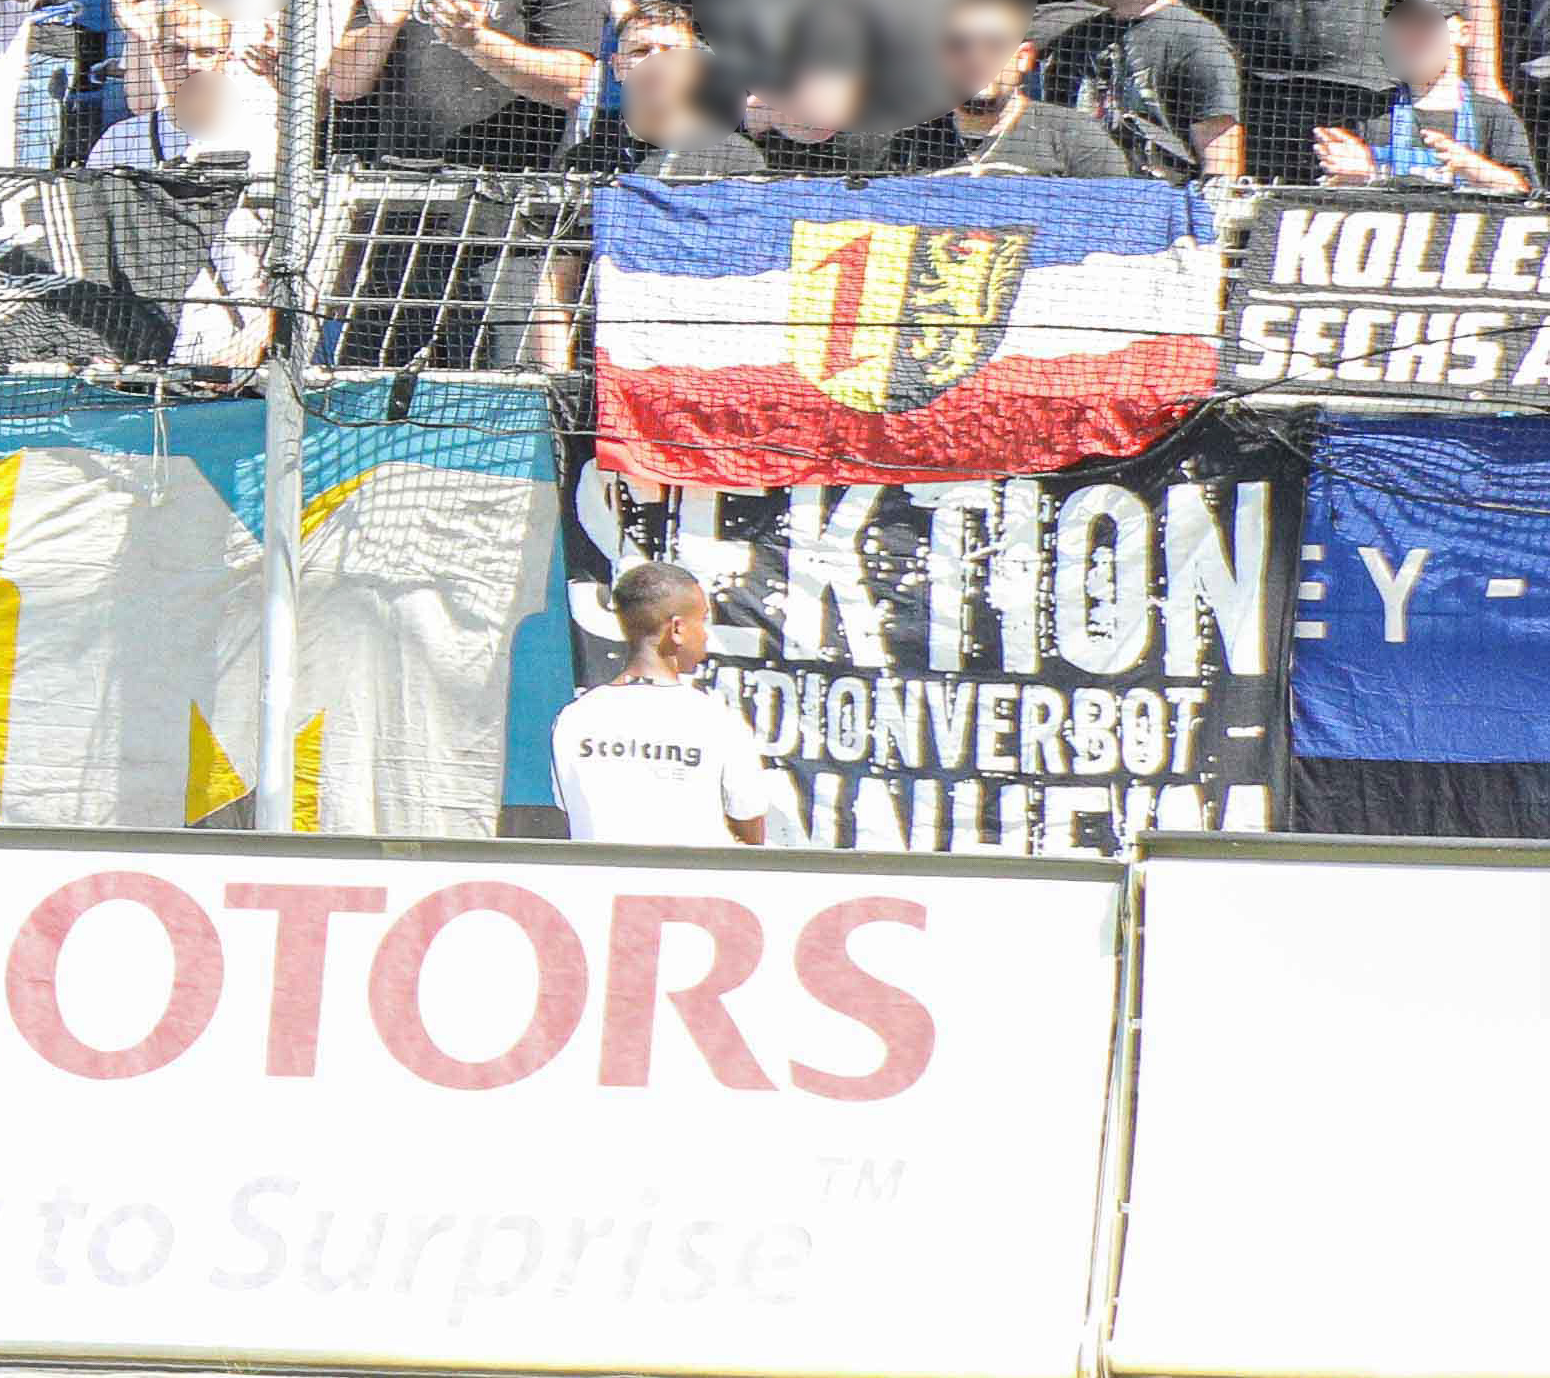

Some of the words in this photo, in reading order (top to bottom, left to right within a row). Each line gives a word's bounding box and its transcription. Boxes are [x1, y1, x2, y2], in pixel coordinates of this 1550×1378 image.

[1235, 303, 1508, 385] SECHS
[579, 735, 702, 771] Stolting
[37, 1189, 177, 1289] to
[209, 1173, 814, 1325] Surprise
